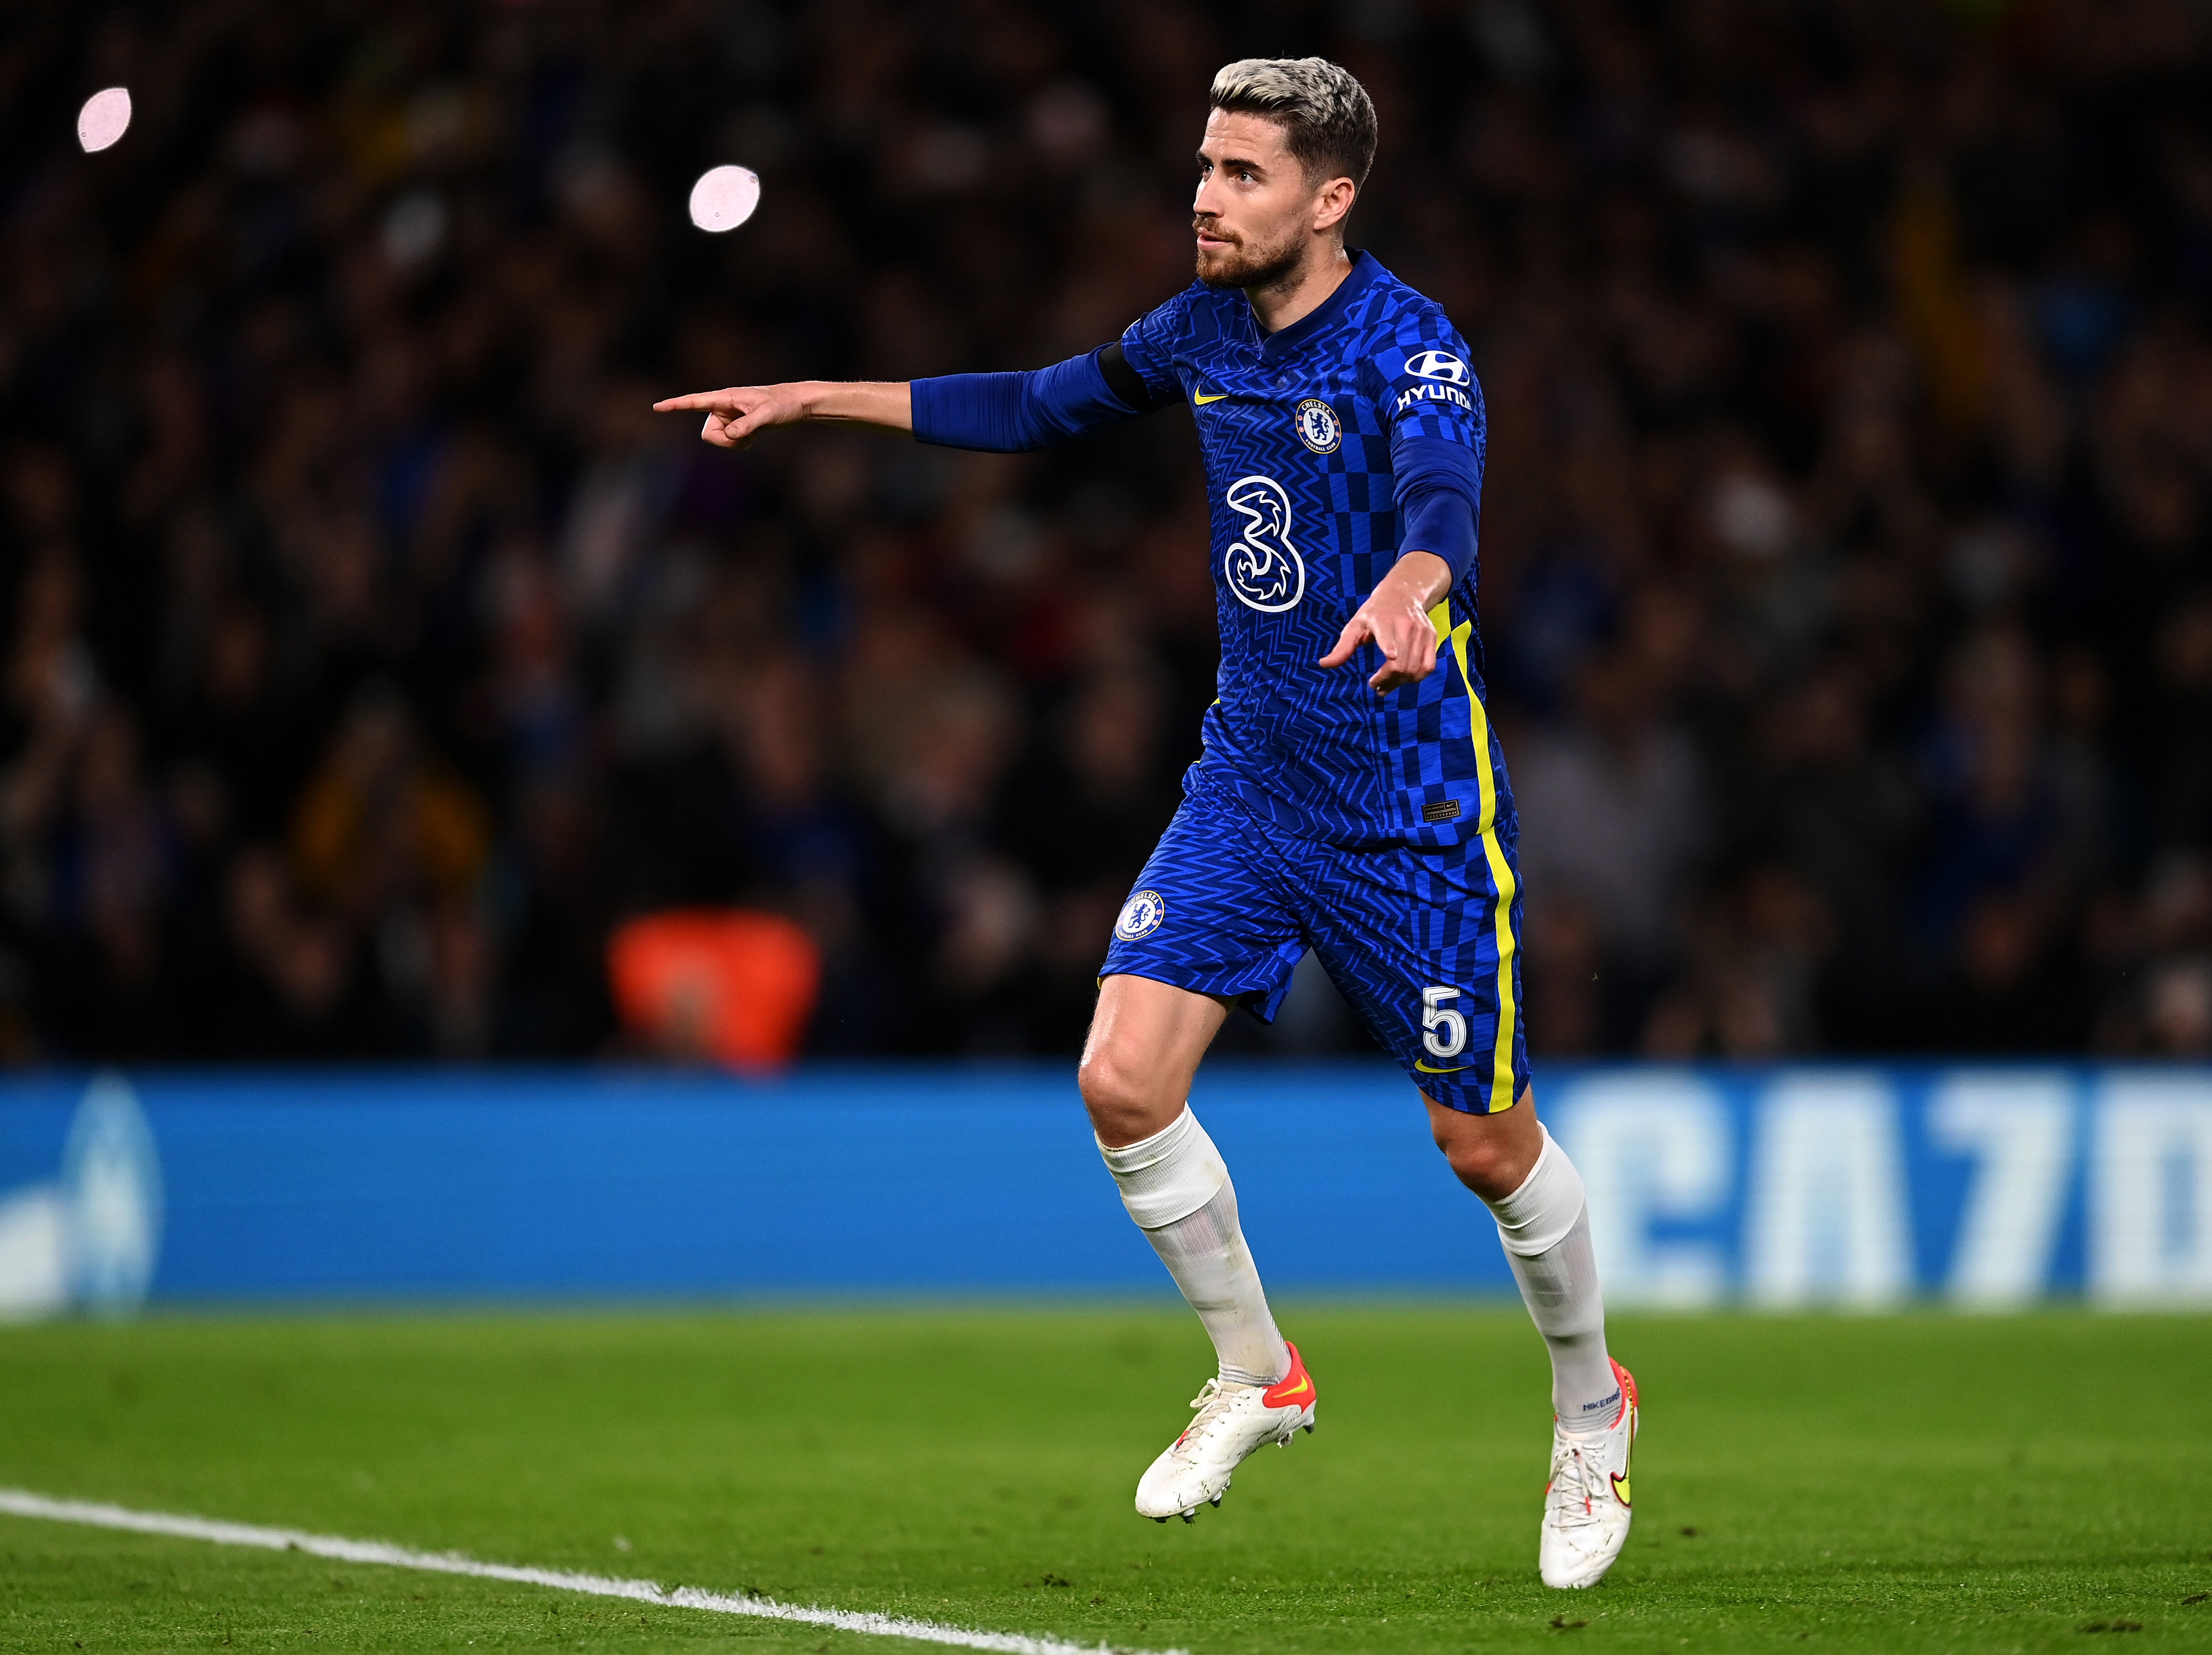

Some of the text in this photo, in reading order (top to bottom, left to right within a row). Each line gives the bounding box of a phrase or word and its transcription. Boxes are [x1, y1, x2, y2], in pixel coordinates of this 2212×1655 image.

[1301, 401, 1330, 415] CHELSEA
[1305, 439, 1336, 451] FOOTBALL CLUB
[1225, 475, 1305, 612] 3
[1131, 892, 1159, 905] CHELSEA
[1422, 986, 1467, 1058] 5
